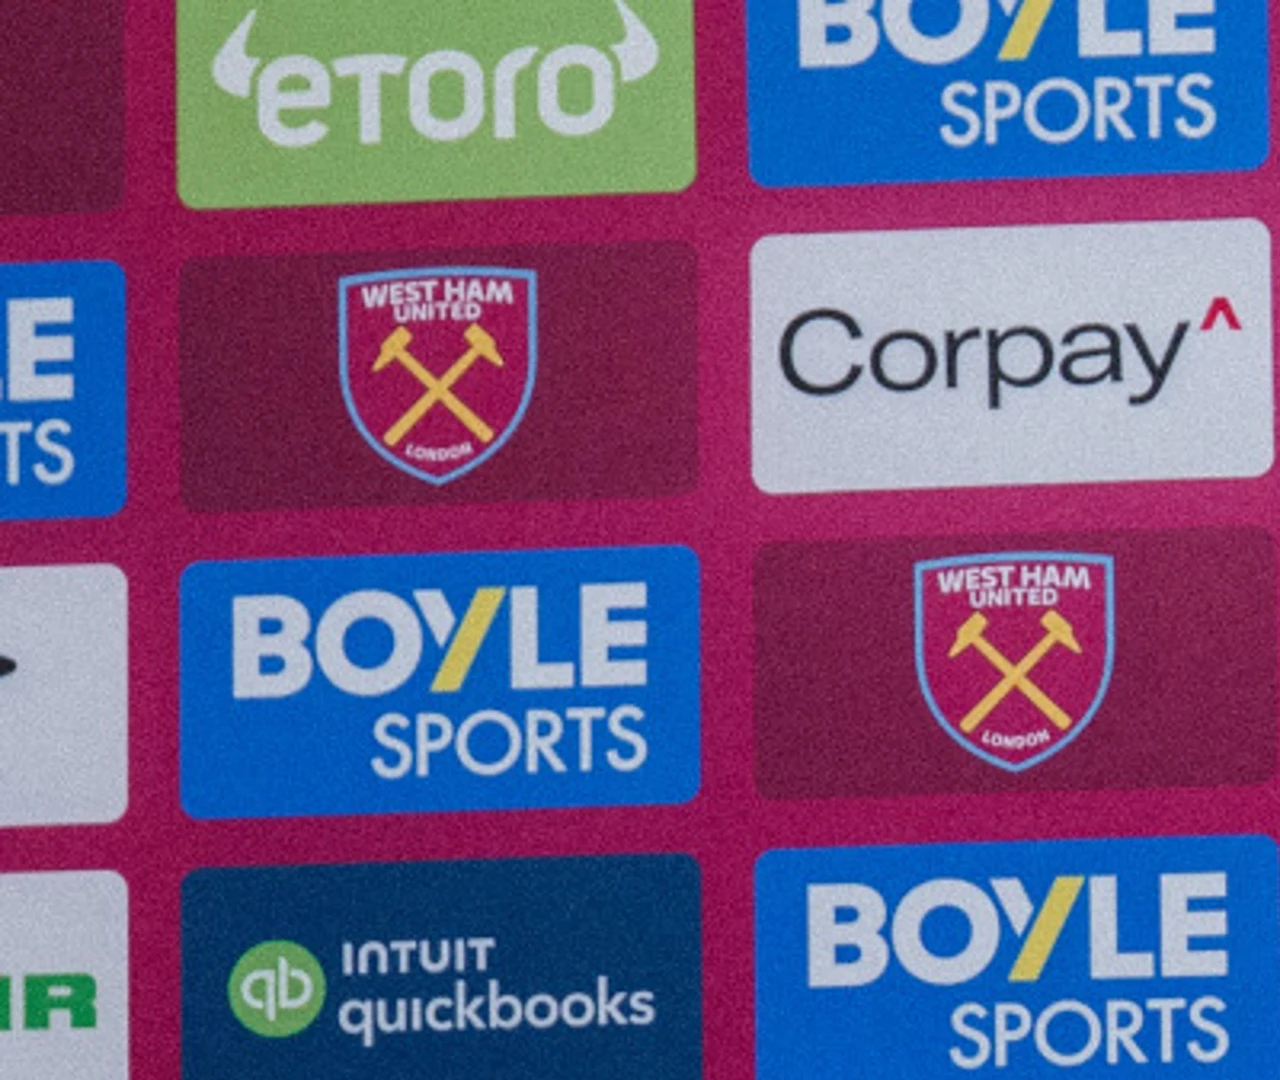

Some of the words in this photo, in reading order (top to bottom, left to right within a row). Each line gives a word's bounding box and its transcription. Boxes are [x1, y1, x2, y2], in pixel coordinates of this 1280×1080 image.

[940, 72, 1217, 148] SPORTS
[362, 281, 442, 308] WEST
[445, 280, 514, 304] HAM
[394, 303, 482, 323] UNITED
[779, 307, 1190, 409] Corpay
[404, 441, 472, 463] LONDON
[937, 567, 1018, 592] WEST
[1020, 563, 1091, 590] HAM
[968, 585, 1058, 607] UNITED
[231, 582, 648, 699] BOYLE
[370, 705, 648, 779] SPORTS
[981, 727, 1051, 750] LONDON
[341, 938, 496, 975] INTUIT
[807, 871, 1229, 988] BOYLE
[240, 957, 313, 1020] qb
[339, 978, 655, 1047] quickbooks
[949, 997, 1230, 1069] SPORTS
